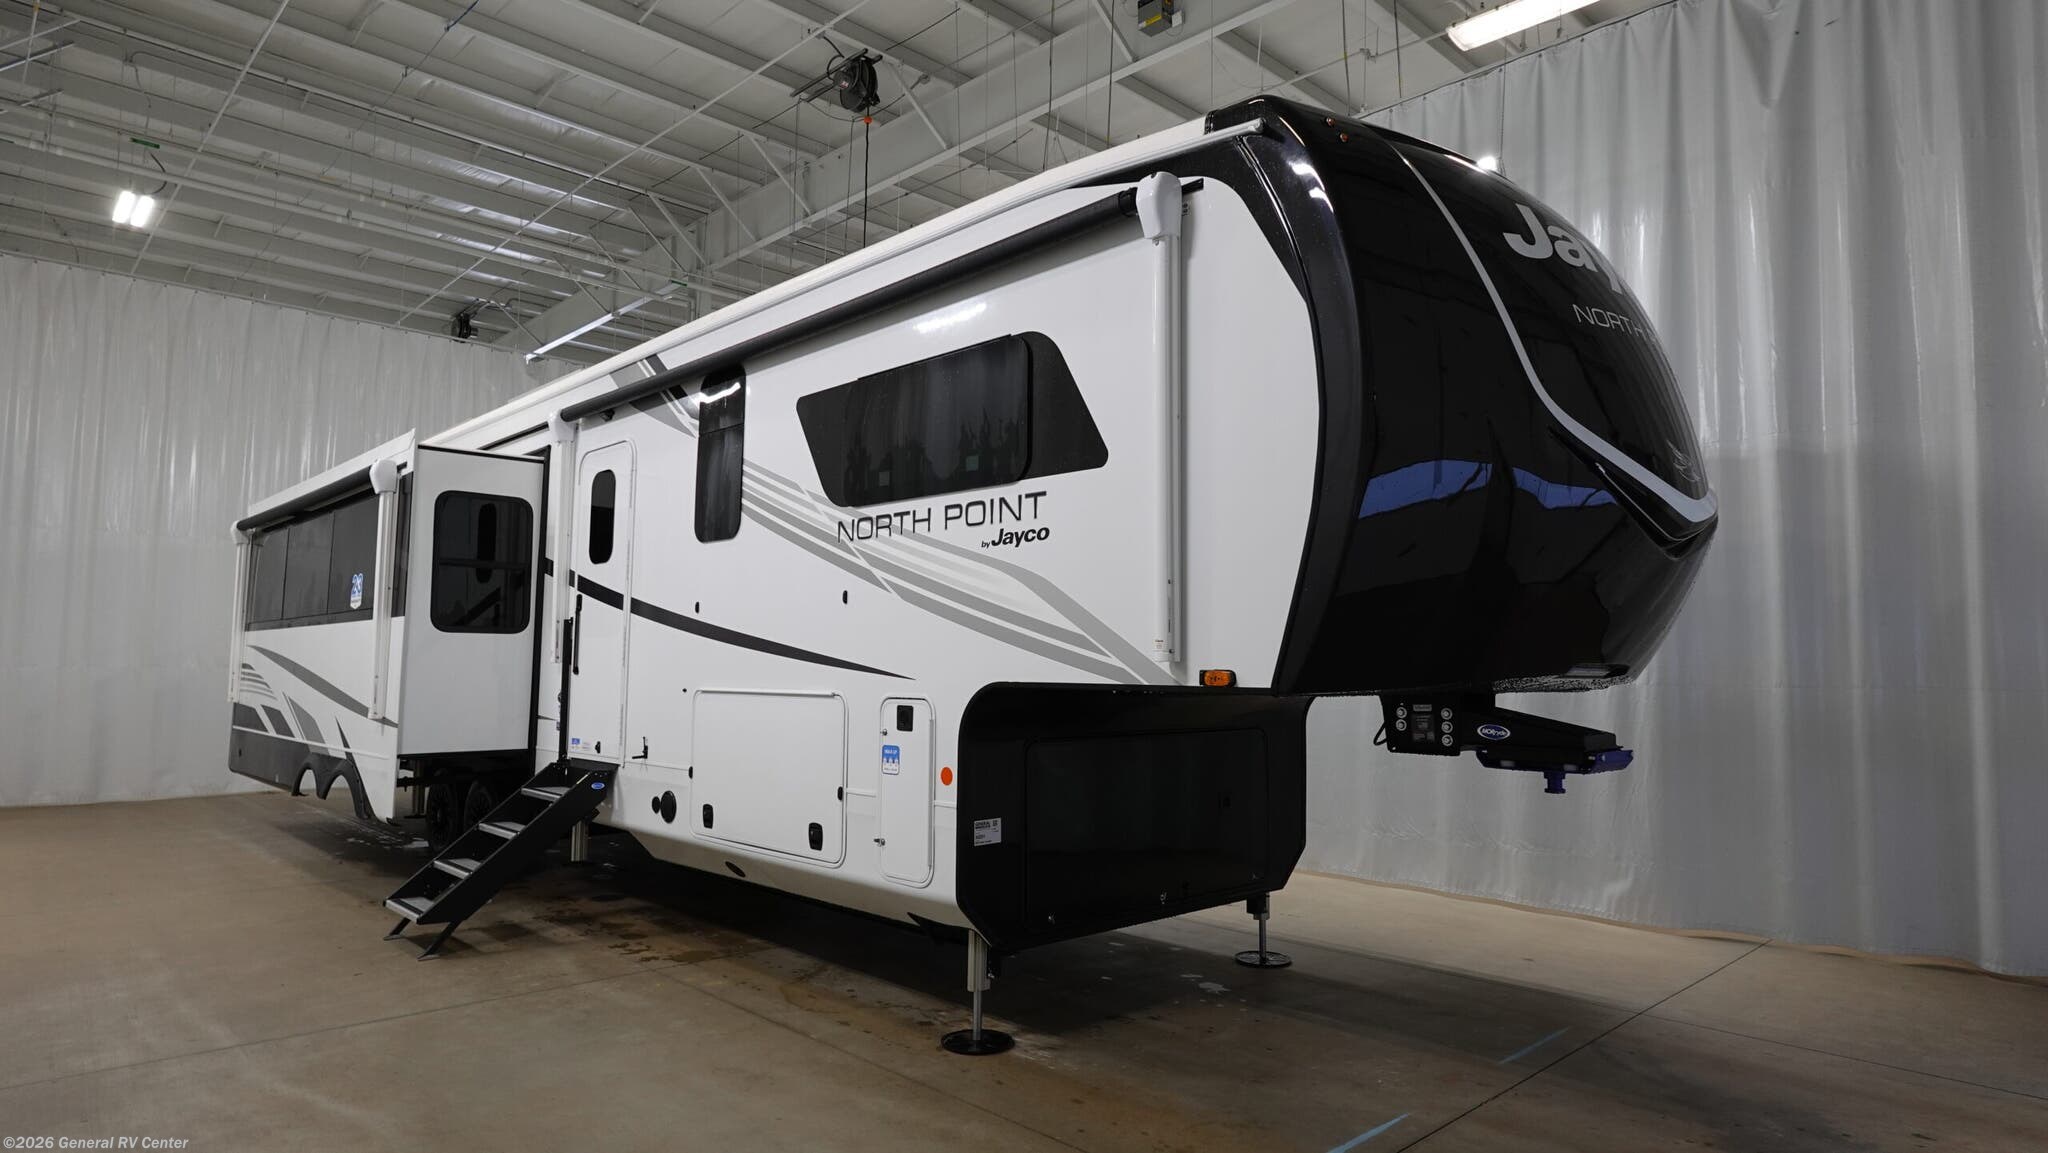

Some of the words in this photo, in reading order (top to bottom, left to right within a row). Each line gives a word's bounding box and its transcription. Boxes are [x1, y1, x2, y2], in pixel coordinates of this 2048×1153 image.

[1572, 303, 1647, 341] NORTH
[837, 508, 931, 543] NORTH
[944, 491, 1047, 531] POINT
[981, 540, 990, 548] by
[991, 527, 1050, 548] Jayco
